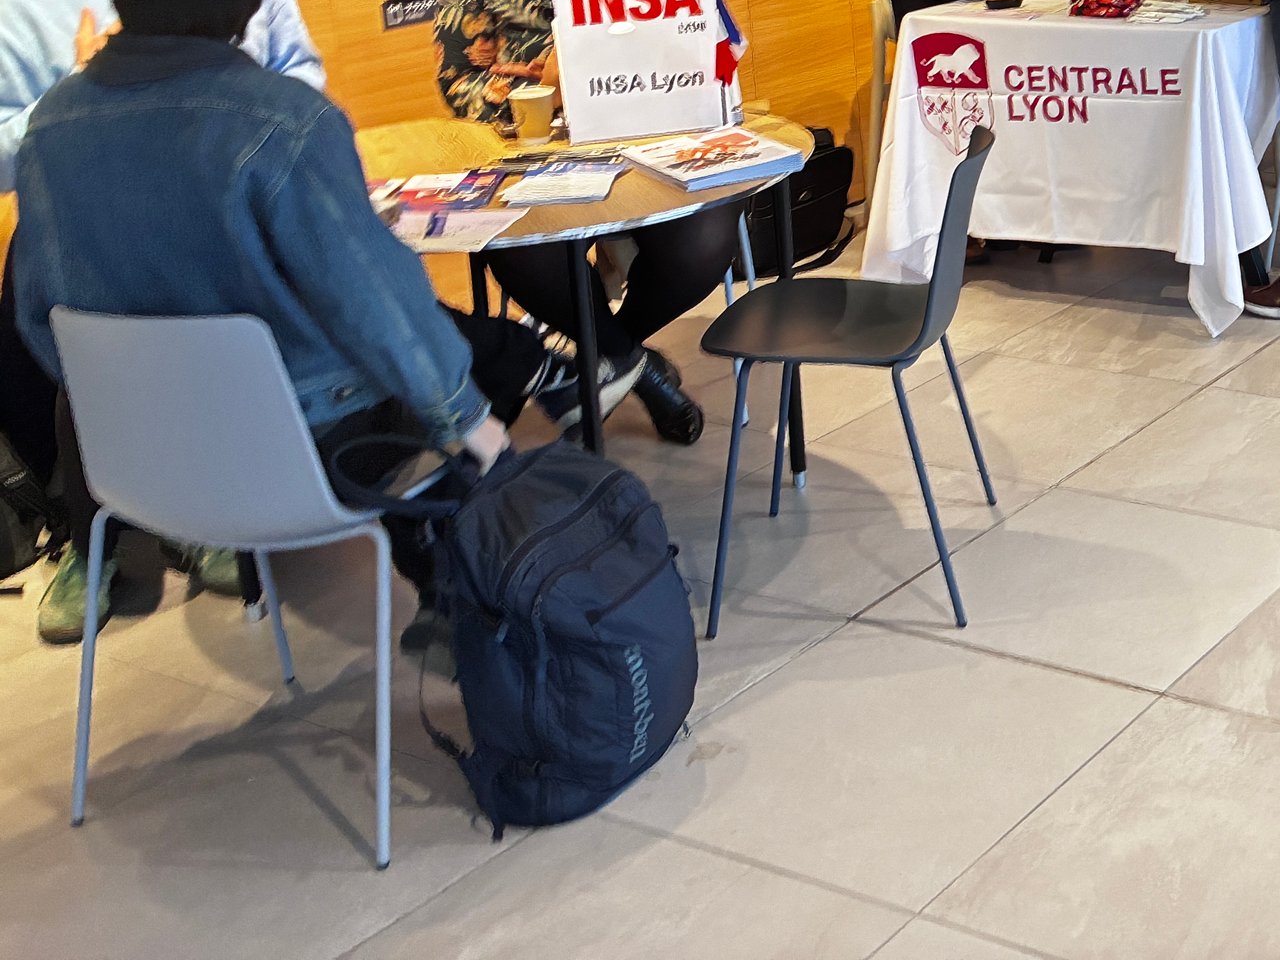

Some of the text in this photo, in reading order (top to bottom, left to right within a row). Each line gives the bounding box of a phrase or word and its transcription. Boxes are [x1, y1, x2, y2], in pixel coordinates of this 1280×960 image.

[589, 70, 706, 98] INSA Lyon
[1004, 64, 1183, 97] CENTRALE
[1007, 96, 1090, 124] LYON
